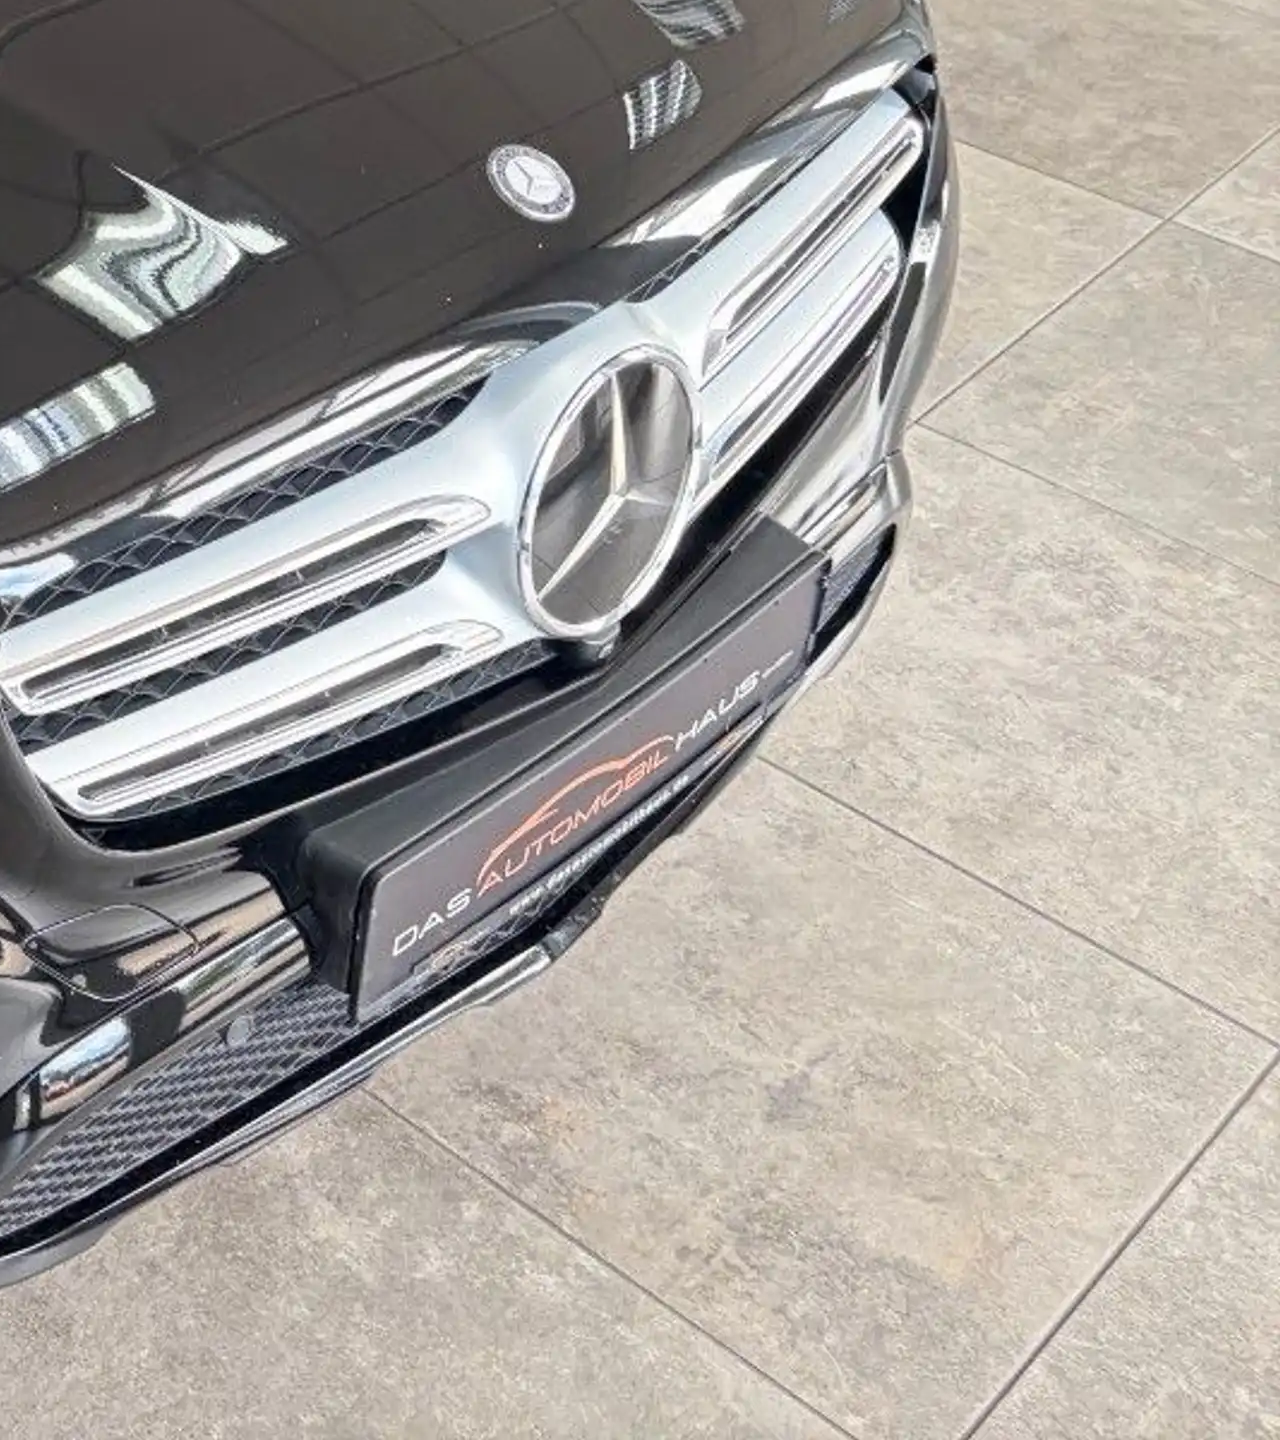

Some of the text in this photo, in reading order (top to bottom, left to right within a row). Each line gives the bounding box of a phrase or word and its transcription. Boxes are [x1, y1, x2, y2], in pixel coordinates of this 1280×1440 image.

[392, 887, 473, 957] DAS
[476, 749, 669, 899] AUTOMOBIL
[674, 670, 761, 752] HAUS
